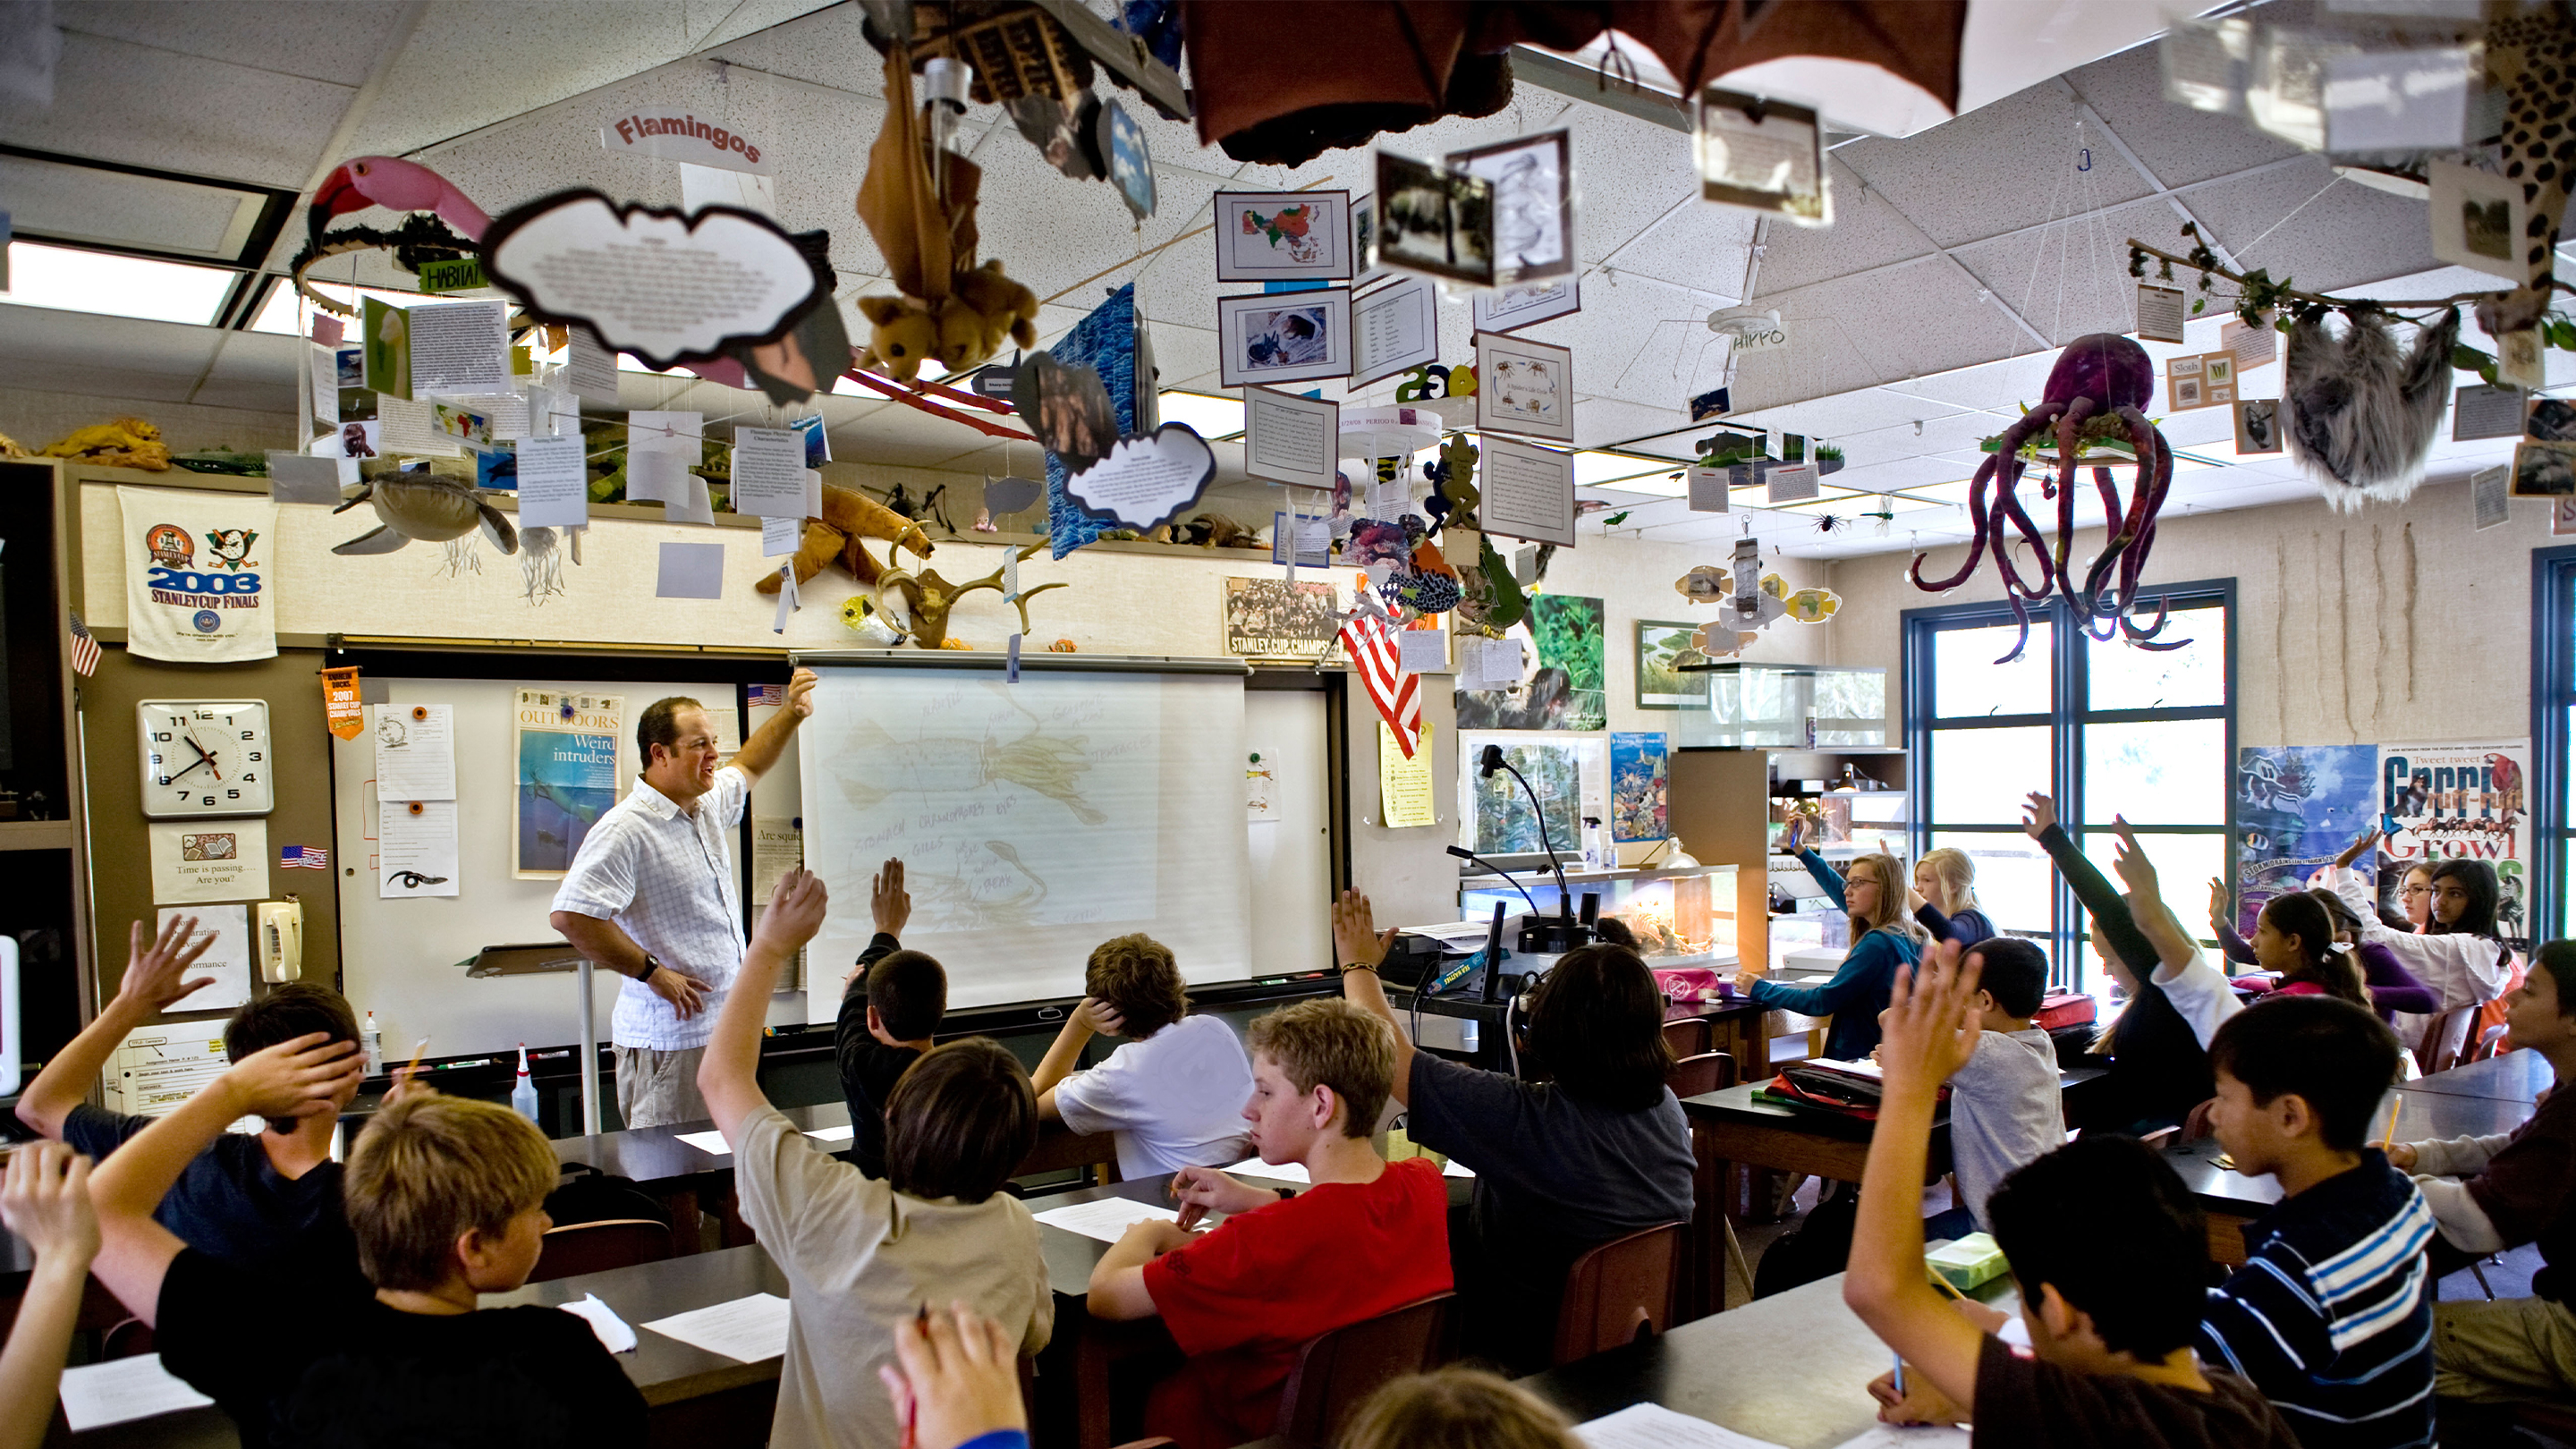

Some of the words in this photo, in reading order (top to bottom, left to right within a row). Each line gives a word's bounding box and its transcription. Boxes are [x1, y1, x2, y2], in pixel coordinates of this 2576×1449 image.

[614, 115, 761, 164] Flamingos
[428, 263, 479, 289] HABITAT
[2174, 361, 2199, 373] Sloth
[148, 567, 262, 595] 2003
[152, 589, 199, 608] STANLEY
[199, 595, 222, 609] CUP
[224, 596, 258, 608] FINALS
[1232, 637, 1268, 653] STANLEY
[1271, 638, 1289, 654] CUP
[333, 691, 353, 701] 2007
[328, 701, 349, 710] STANLEY
[193, 710, 214, 720] 12
[329, 709, 361, 718] CHAMPIONS
[170, 716, 186, 726] 11
[225, 716, 233, 725] 1
[151, 733, 172, 741] 10
[242, 731, 254, 741] 2
[573, 735, 615, 750] Weird
[150, 754, 163, 764] 9
[250, 752, 262, 761] 3
[554, 748, 615, 764] intruders
[2450, 756, 2479, 764] tweet
[242, 773, 256, 783] 4
[177, 791, 190, 801] 7
[228, 789, 240, 799] 5
[203, 796, 216, 806] 6
[758, 828, 775, 841] Are
[777, 829, 803, 843] squid
[2384, 828, 2519, 860] Growl
[176, 866, 199, 874] Time
[202, 865, 209, 873] is
[211, 864, 257, 875] passing....
[2244, 861, 2269, 877] STORM
[2269, 858, 2291, 867] DRAINS
[196, 876, 212, 884] Are
[214, 875, 235, 886] you?
[1462, 964, 1470, 973] SEA
[1444, 970, 1462, 985] NASTIES
